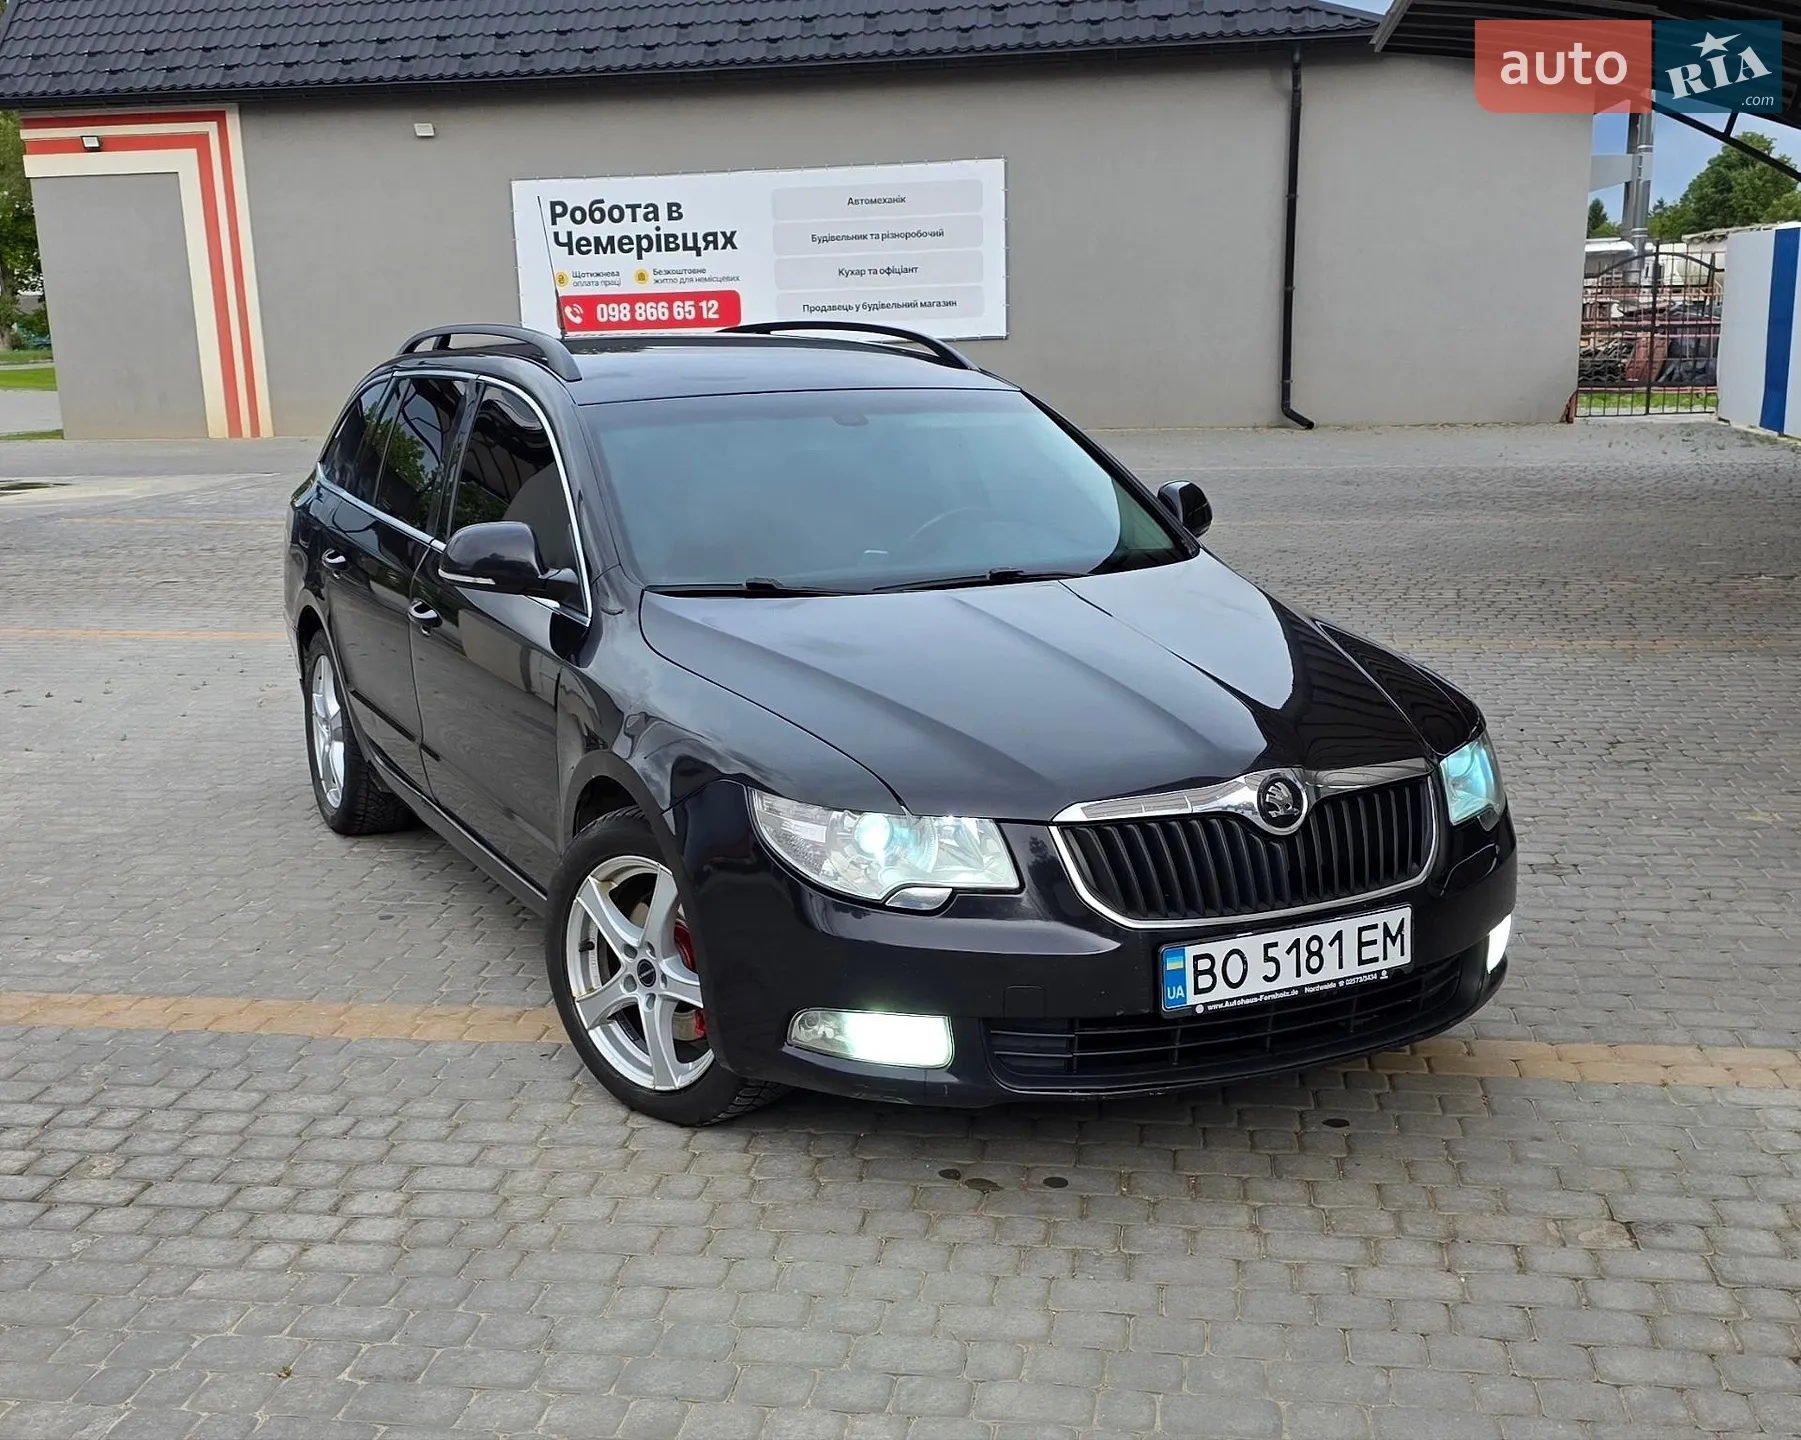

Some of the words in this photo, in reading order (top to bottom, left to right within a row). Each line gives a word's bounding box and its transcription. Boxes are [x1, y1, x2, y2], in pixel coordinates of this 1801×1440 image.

[847, 195, 907, 206] Автомеханік
[549, 198, 660, 226] Робота
[667, 202, 684, 222] в
[553, 226, 738, 260] Чемерівцях
[811, 233, 869, 245] Будівельник
[869, 231, 881, 241] та
[881, 229, 945, 243] різноробочий
[652, 267, 707, 276] Безкоштовне
[838, 266, 867, 278] Кухар
[867, 267, 879, 276] та
[879, 265, 919, 277] офіціант
[596, 303, 630, 323] 098
[634, 302, 669, 322] 866
[671, 301, 696, 321] 65
[699, 299, 720, 319] 12
[802, 302, 854, 314] Продавець
[854, 303, 861, 313] у
[861, 299, 919, 311] будівельний
[920, 299, 957, 309] магазин
[1192, 947, 1249, 996] BO
[1262, 929, 1345, 984] 5181
[1356, 917, 1406, 967] EM
[1166, 985, 1186, 1001] UA
